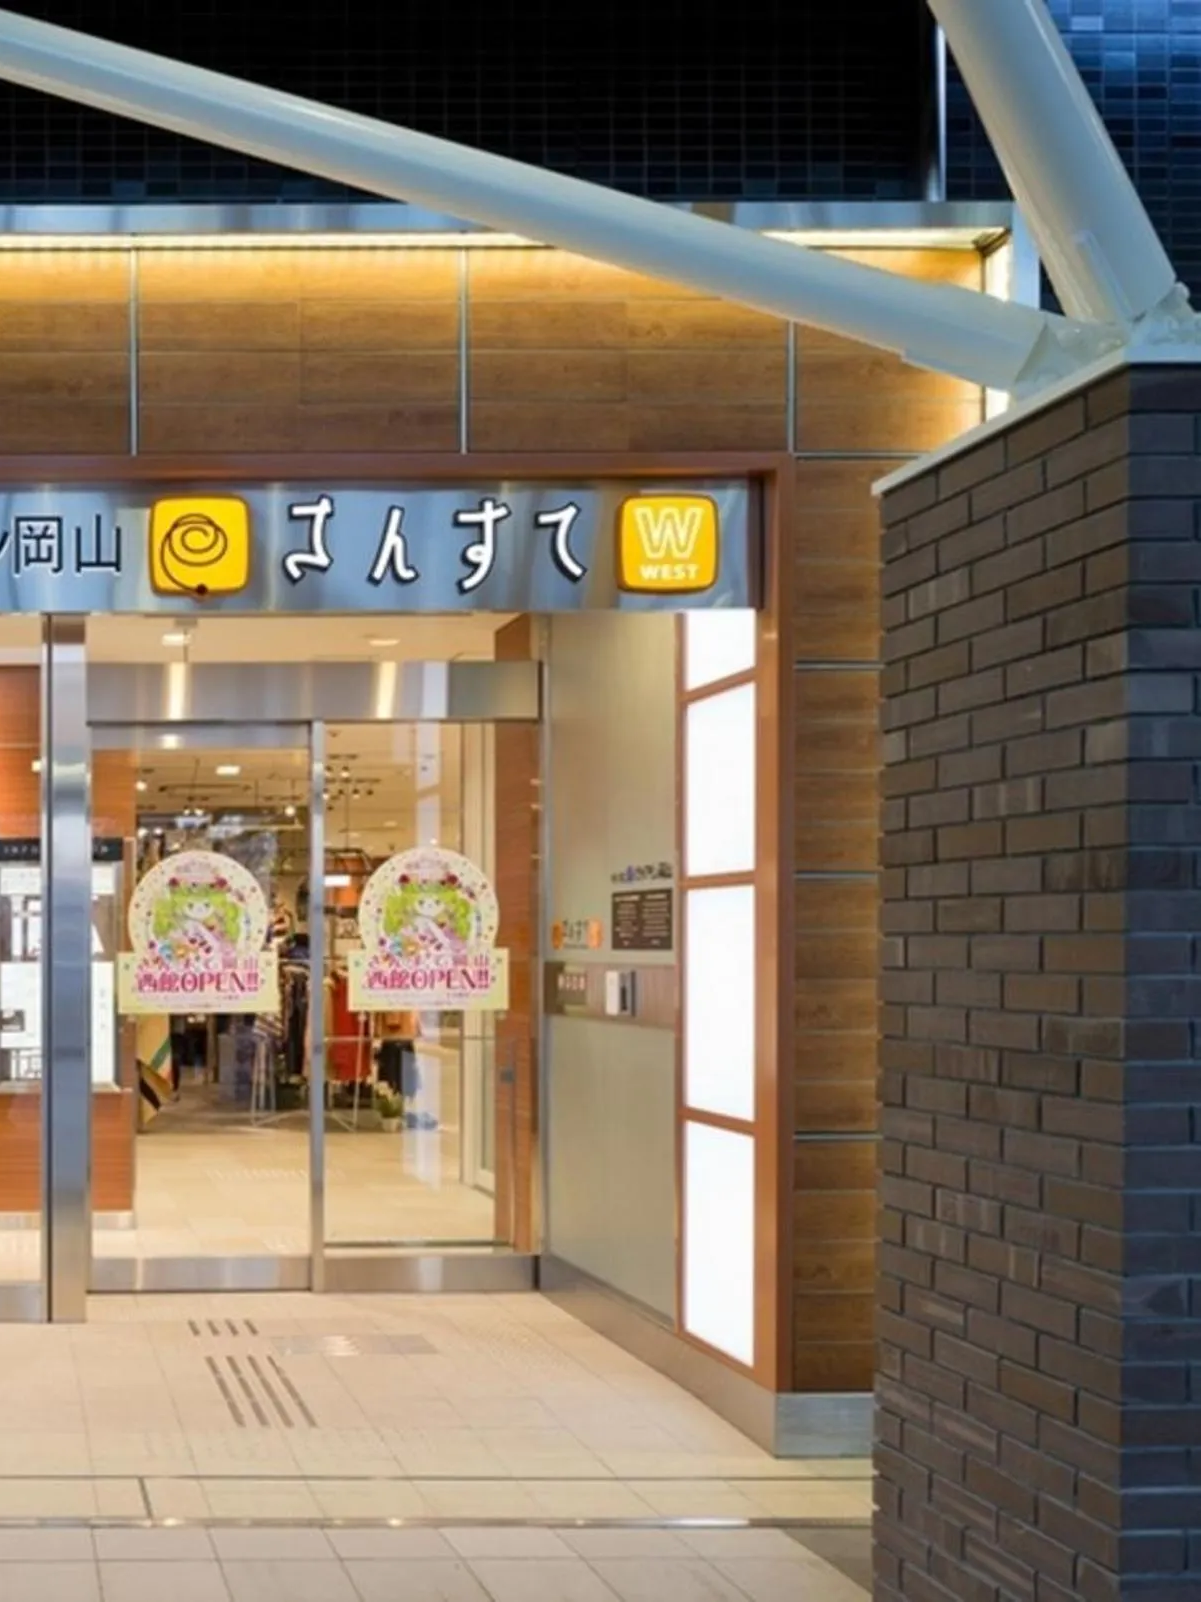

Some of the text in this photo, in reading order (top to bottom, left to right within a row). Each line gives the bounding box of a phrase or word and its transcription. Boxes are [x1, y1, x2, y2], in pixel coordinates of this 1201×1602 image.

[284, 494, 587, 593] さんすて
[640, 563, 699, 581] WEST
